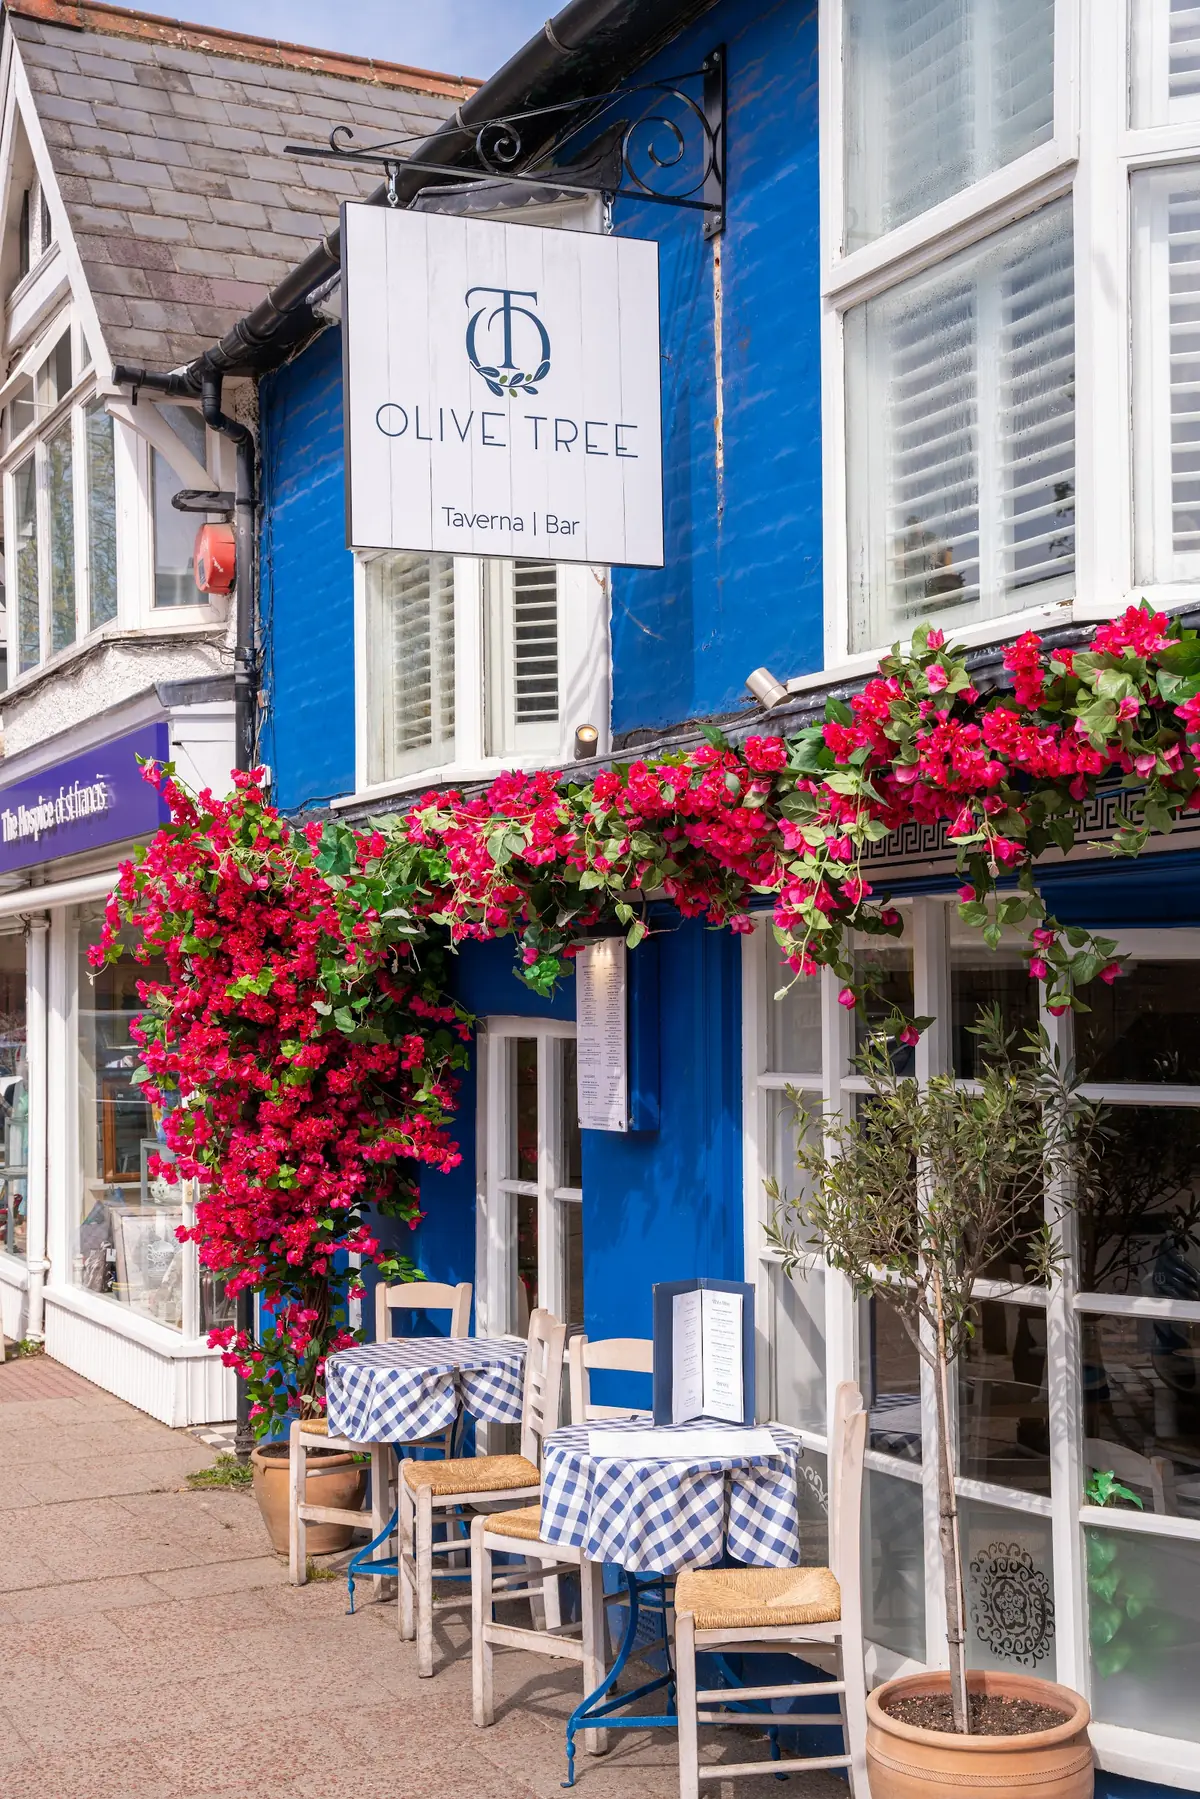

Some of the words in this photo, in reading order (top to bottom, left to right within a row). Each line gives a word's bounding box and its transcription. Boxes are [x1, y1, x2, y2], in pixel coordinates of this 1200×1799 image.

[375, 403, 507, 447] OLIVE
[524, 415, 639, 458] TREE
[441, 506, 524, 532] Taverna
[545, 514, 580, 536] Bar
[1, 808, 17, 842] The
[18, 795, 54, 841] Hospice
[55, 786, 65, 824] of
